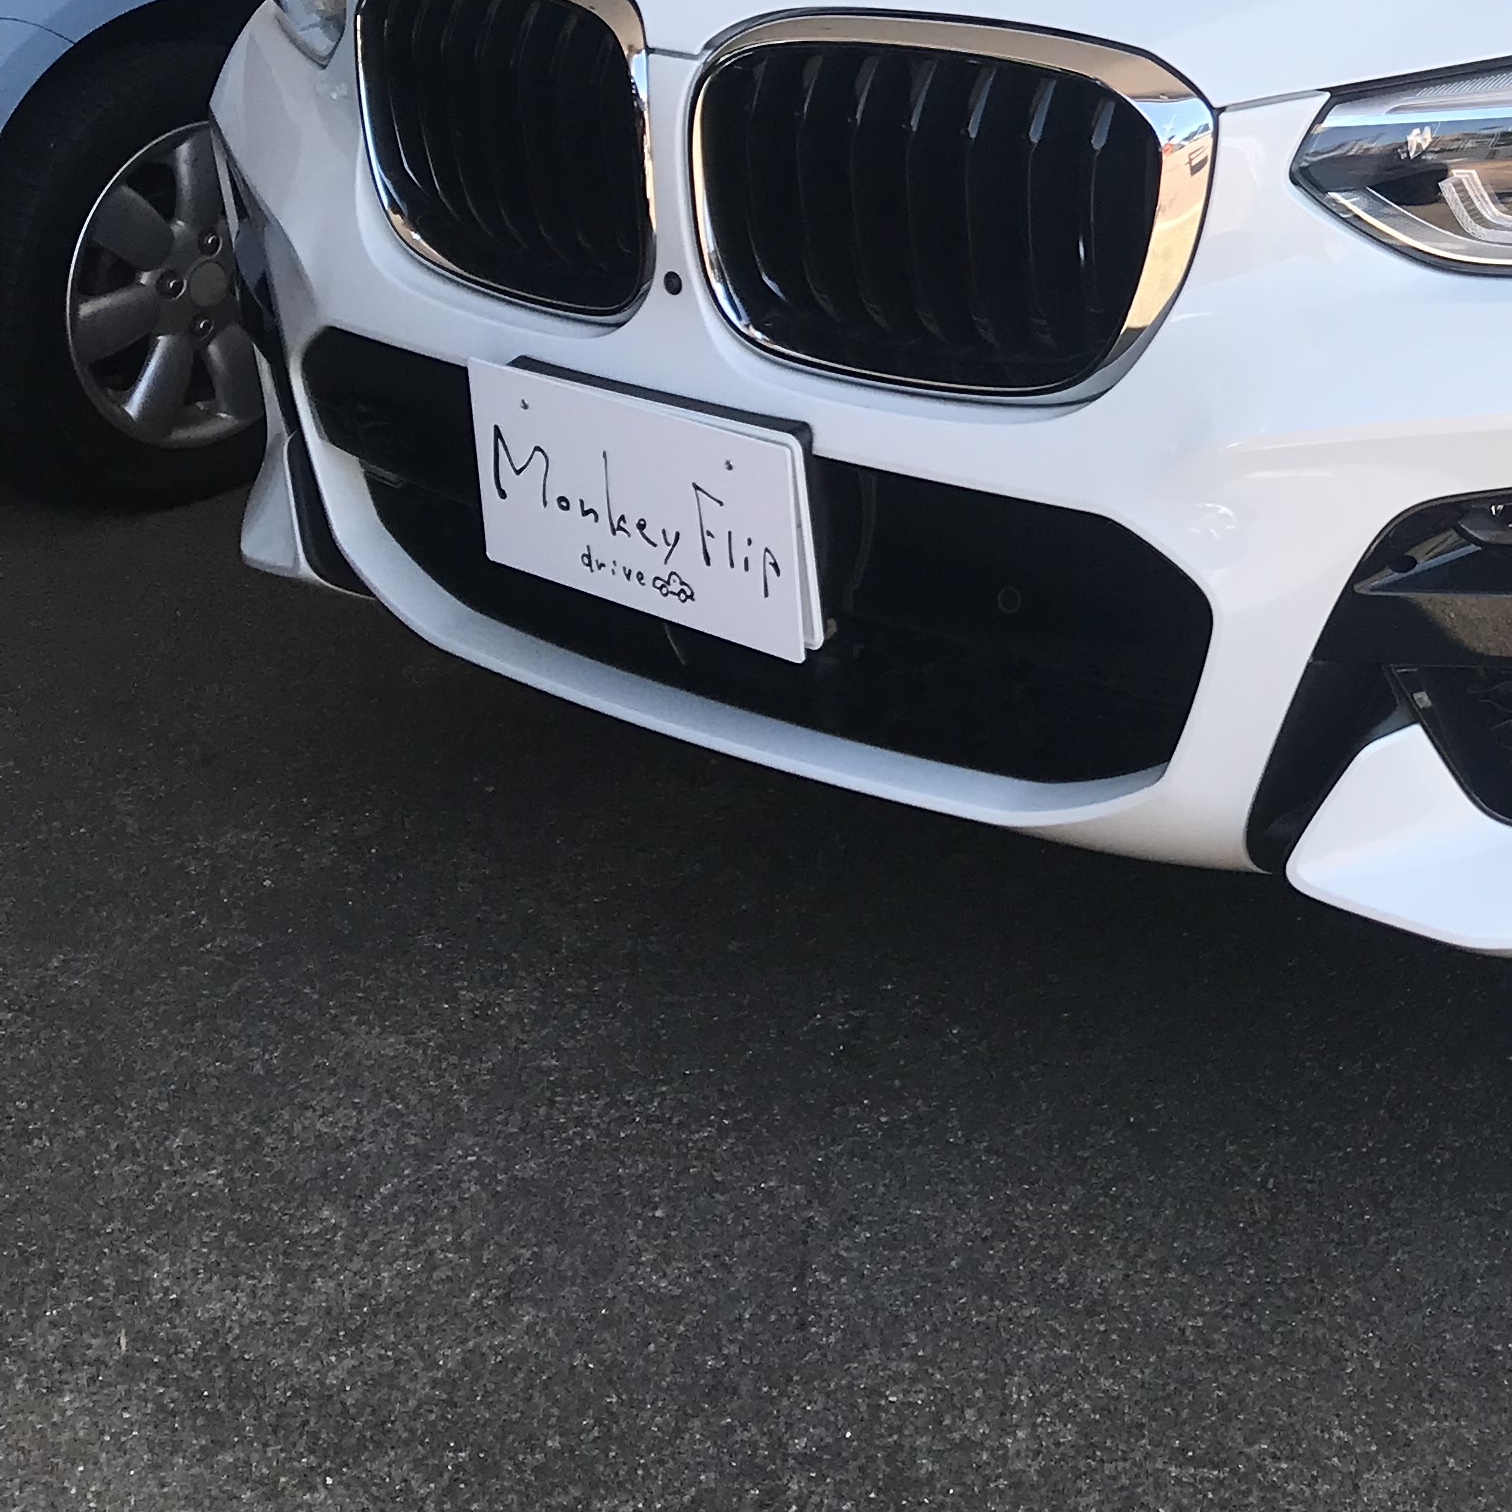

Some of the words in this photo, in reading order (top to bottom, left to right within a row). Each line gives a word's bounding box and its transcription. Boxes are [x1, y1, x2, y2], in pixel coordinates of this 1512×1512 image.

[492, 423, 681, 565] Monkey
[691, 481, 782, 599] Flip
[580, 543, 646, 587] drive
